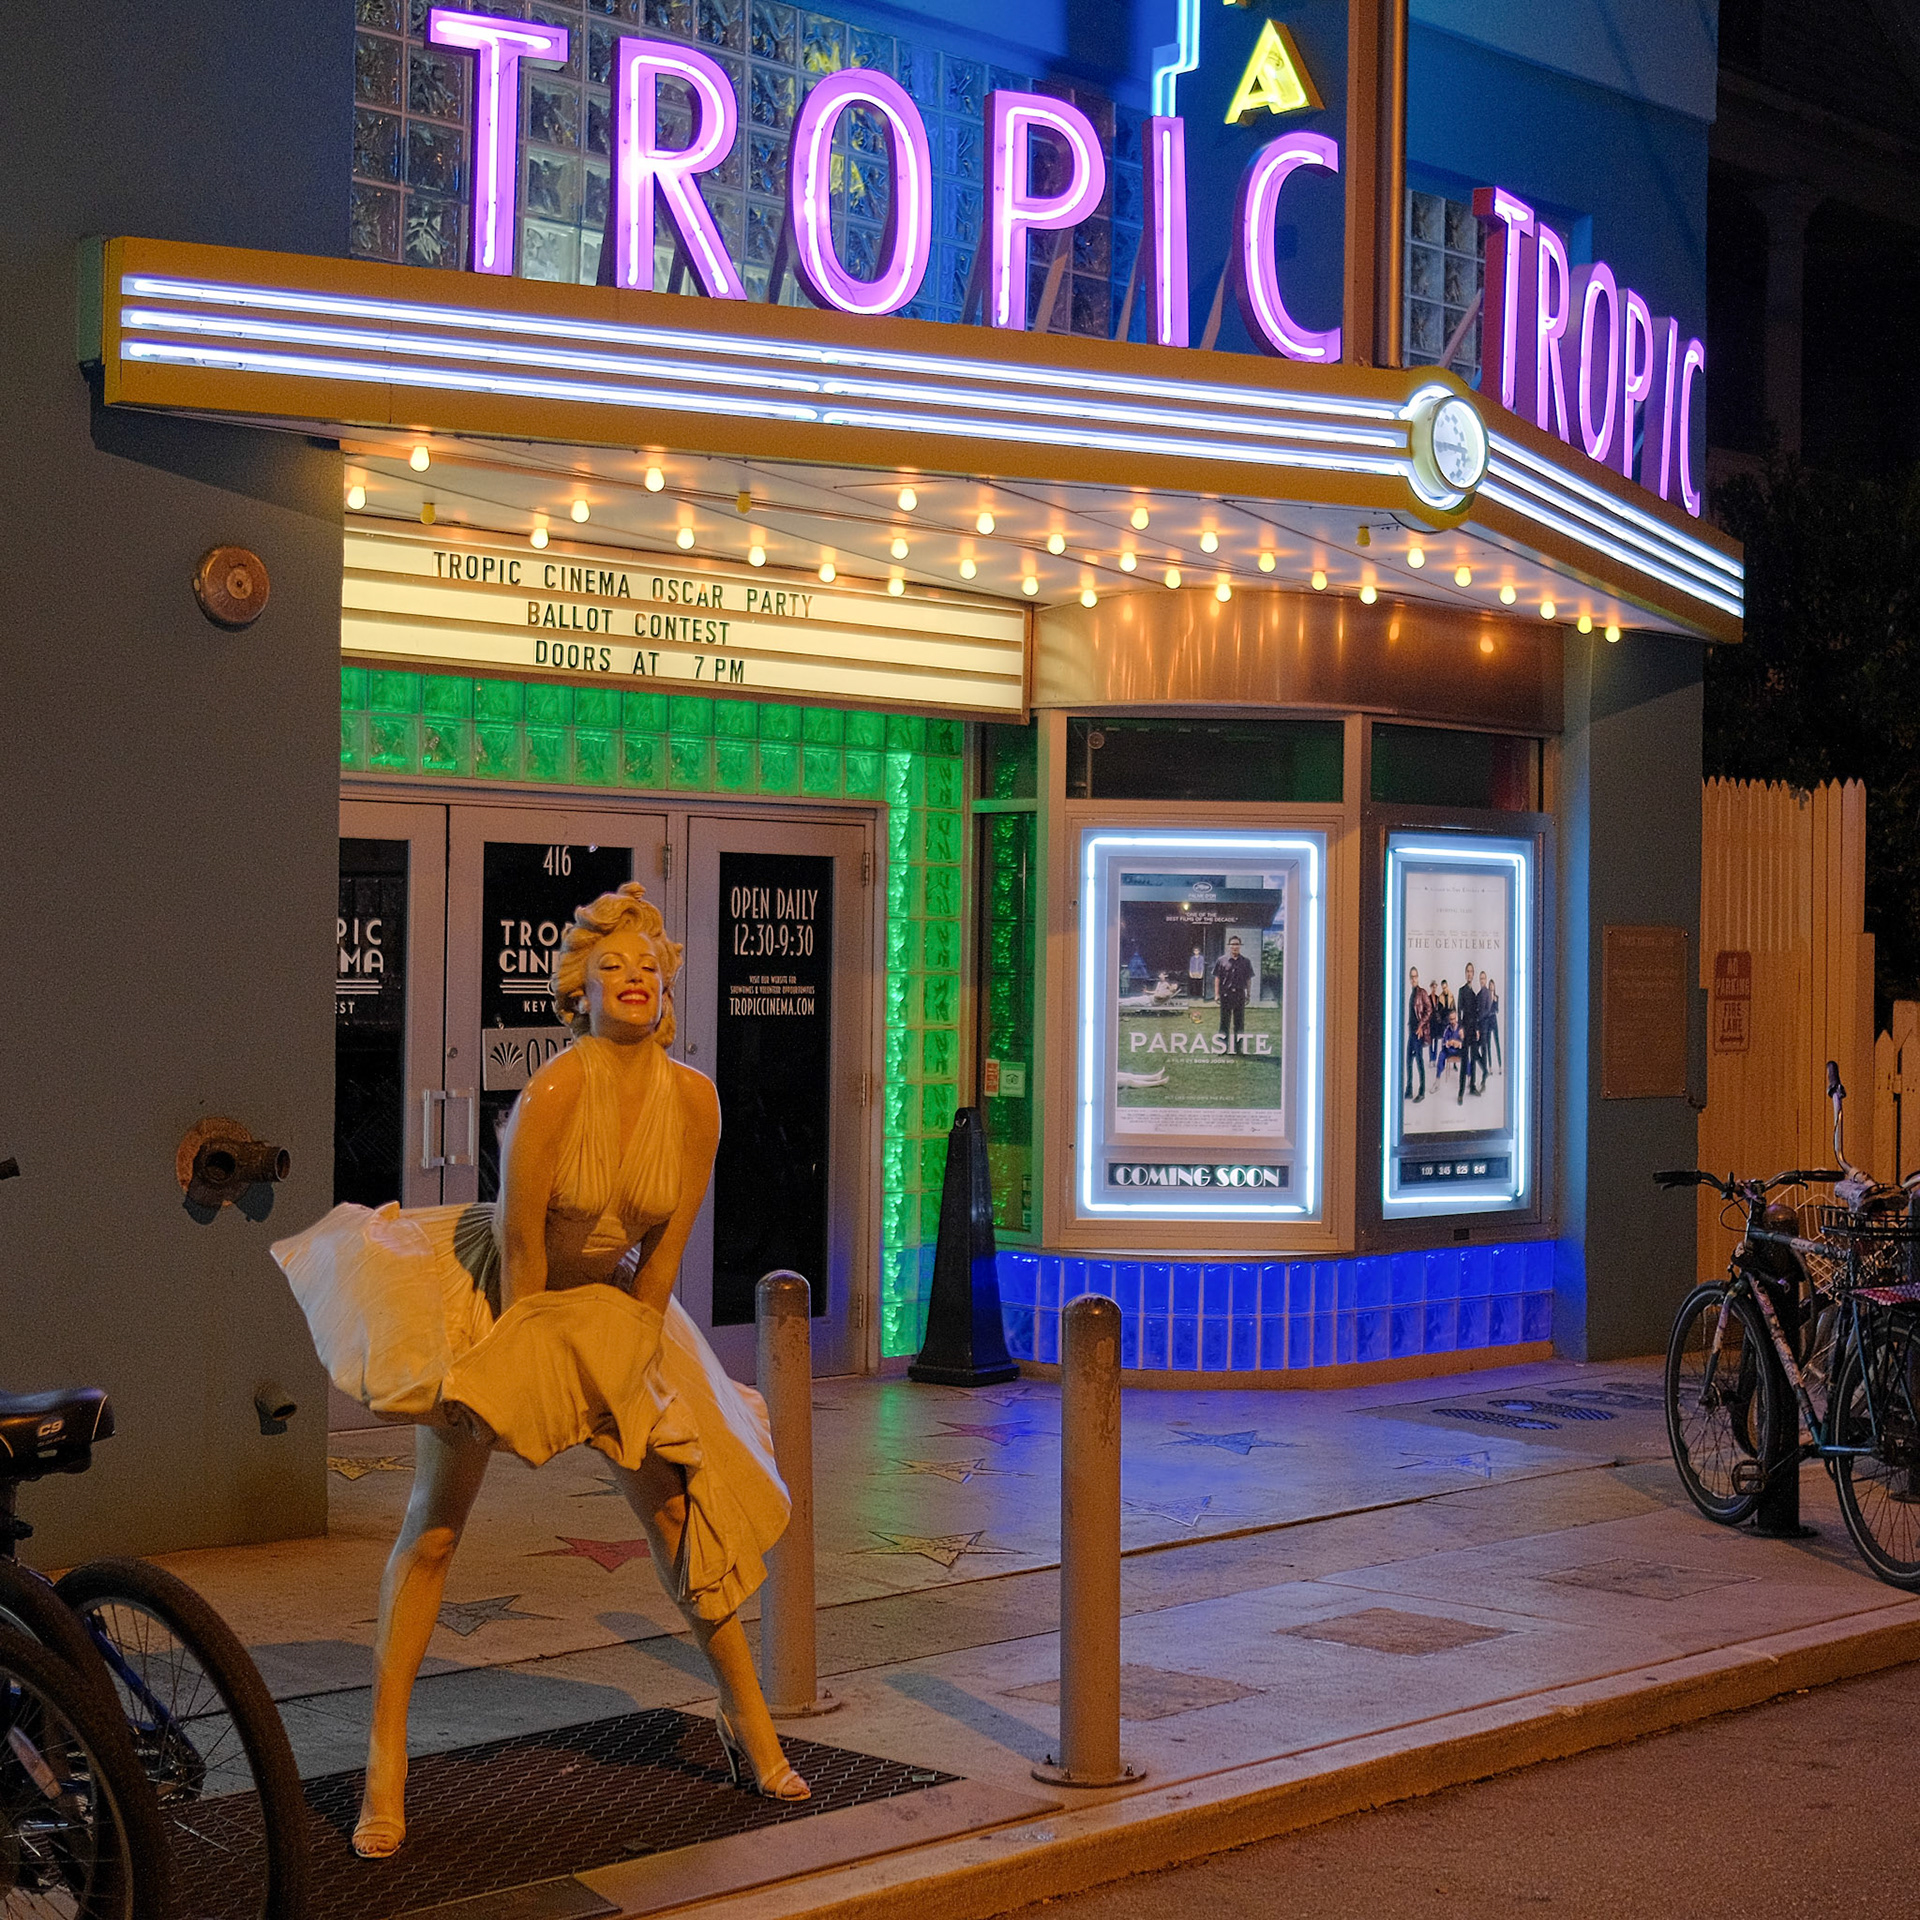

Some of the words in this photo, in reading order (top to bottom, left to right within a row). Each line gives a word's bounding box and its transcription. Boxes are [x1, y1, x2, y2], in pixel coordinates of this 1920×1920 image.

[427, 7, 1341, 363] TROPIC
[1490, 186, 1704, 518] TROPIC
[434, 552, 521, 585] TROPIC
[544, 564, 631, 599] CINEMA
[651, 577, 724, 609] OSCAR
[747, 588, 814, 618] PARTY
[527, 601, 613, 634] BALLOT
[634, 613, 730, 645] CONTEST
[535, 640, 611, 671] DOORS
[632, 652, 660, 676] AT
[694, 656, 704, 680] 7
[714, 658, 745, 684] PM
[543, 845, 572, 876] 416
[731, 886, 770, 919] OPEN
[776, 888, 818, 920] DAILY
[500, 920, 574, 947] TRO
[734, 923, 814, 956] 12:30-9:30
[1408, 937, 1430, 948] THE
[1435, 938, 1500, 950] GENTLEMEN
[524, 1000, 547, 1012] KEY
[729, 997, 815, 1016] TROPICCINEMA.COM
[1724, 1002, 1742, 1018] FIRE
[1722, 1018, 1743, 1034] LANE
[1128, 1031, 1273, 1055] PARASITE
[1115, 1166, 1211, 1187] COMING
[1215, 1167, 1280, 1188] SOON
